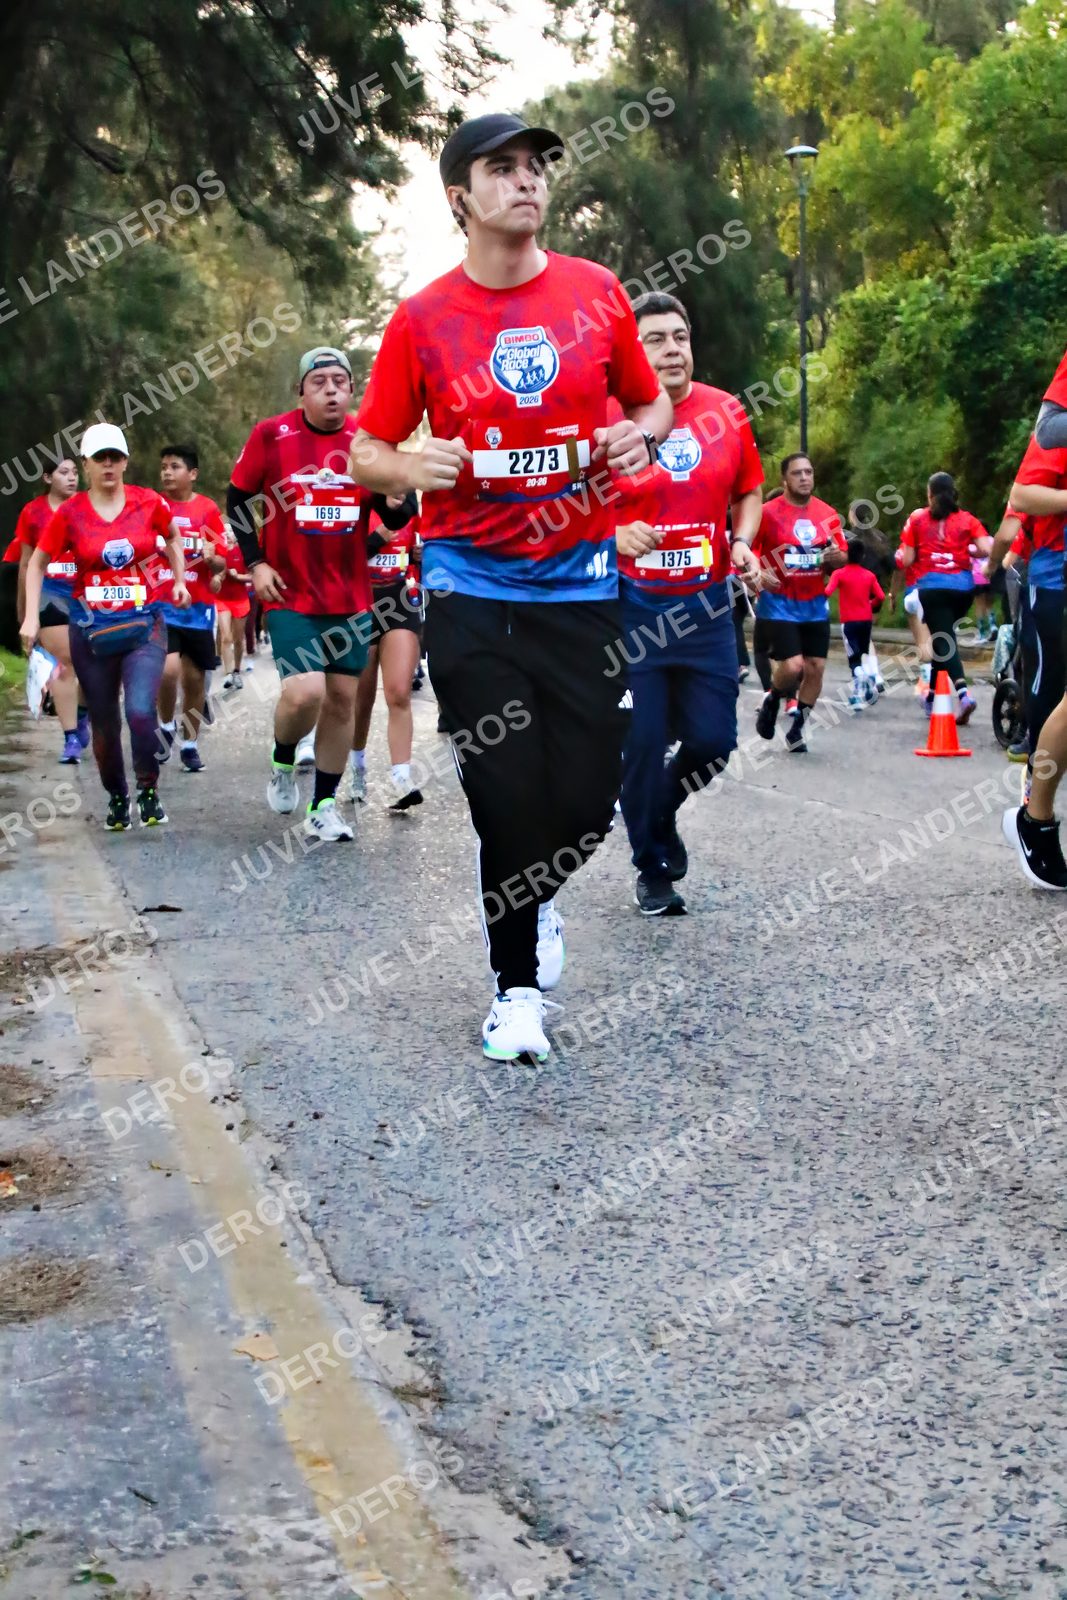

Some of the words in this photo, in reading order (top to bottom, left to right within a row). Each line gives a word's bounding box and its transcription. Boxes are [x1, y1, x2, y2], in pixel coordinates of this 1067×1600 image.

[504, 333, 540, 344] BIMBO
[507, 346, 541, 361] Global
[502, 359, 529, 371] Race
[519, 395, 540, 405] 2026
[508, 447, 560, 475] 2273
[315, 507, 341, 520] 1693
[375, 555, 397, 566] 2213
[660, 550, 692, 569] 1375
[103, 586, 131, 600] 2303
